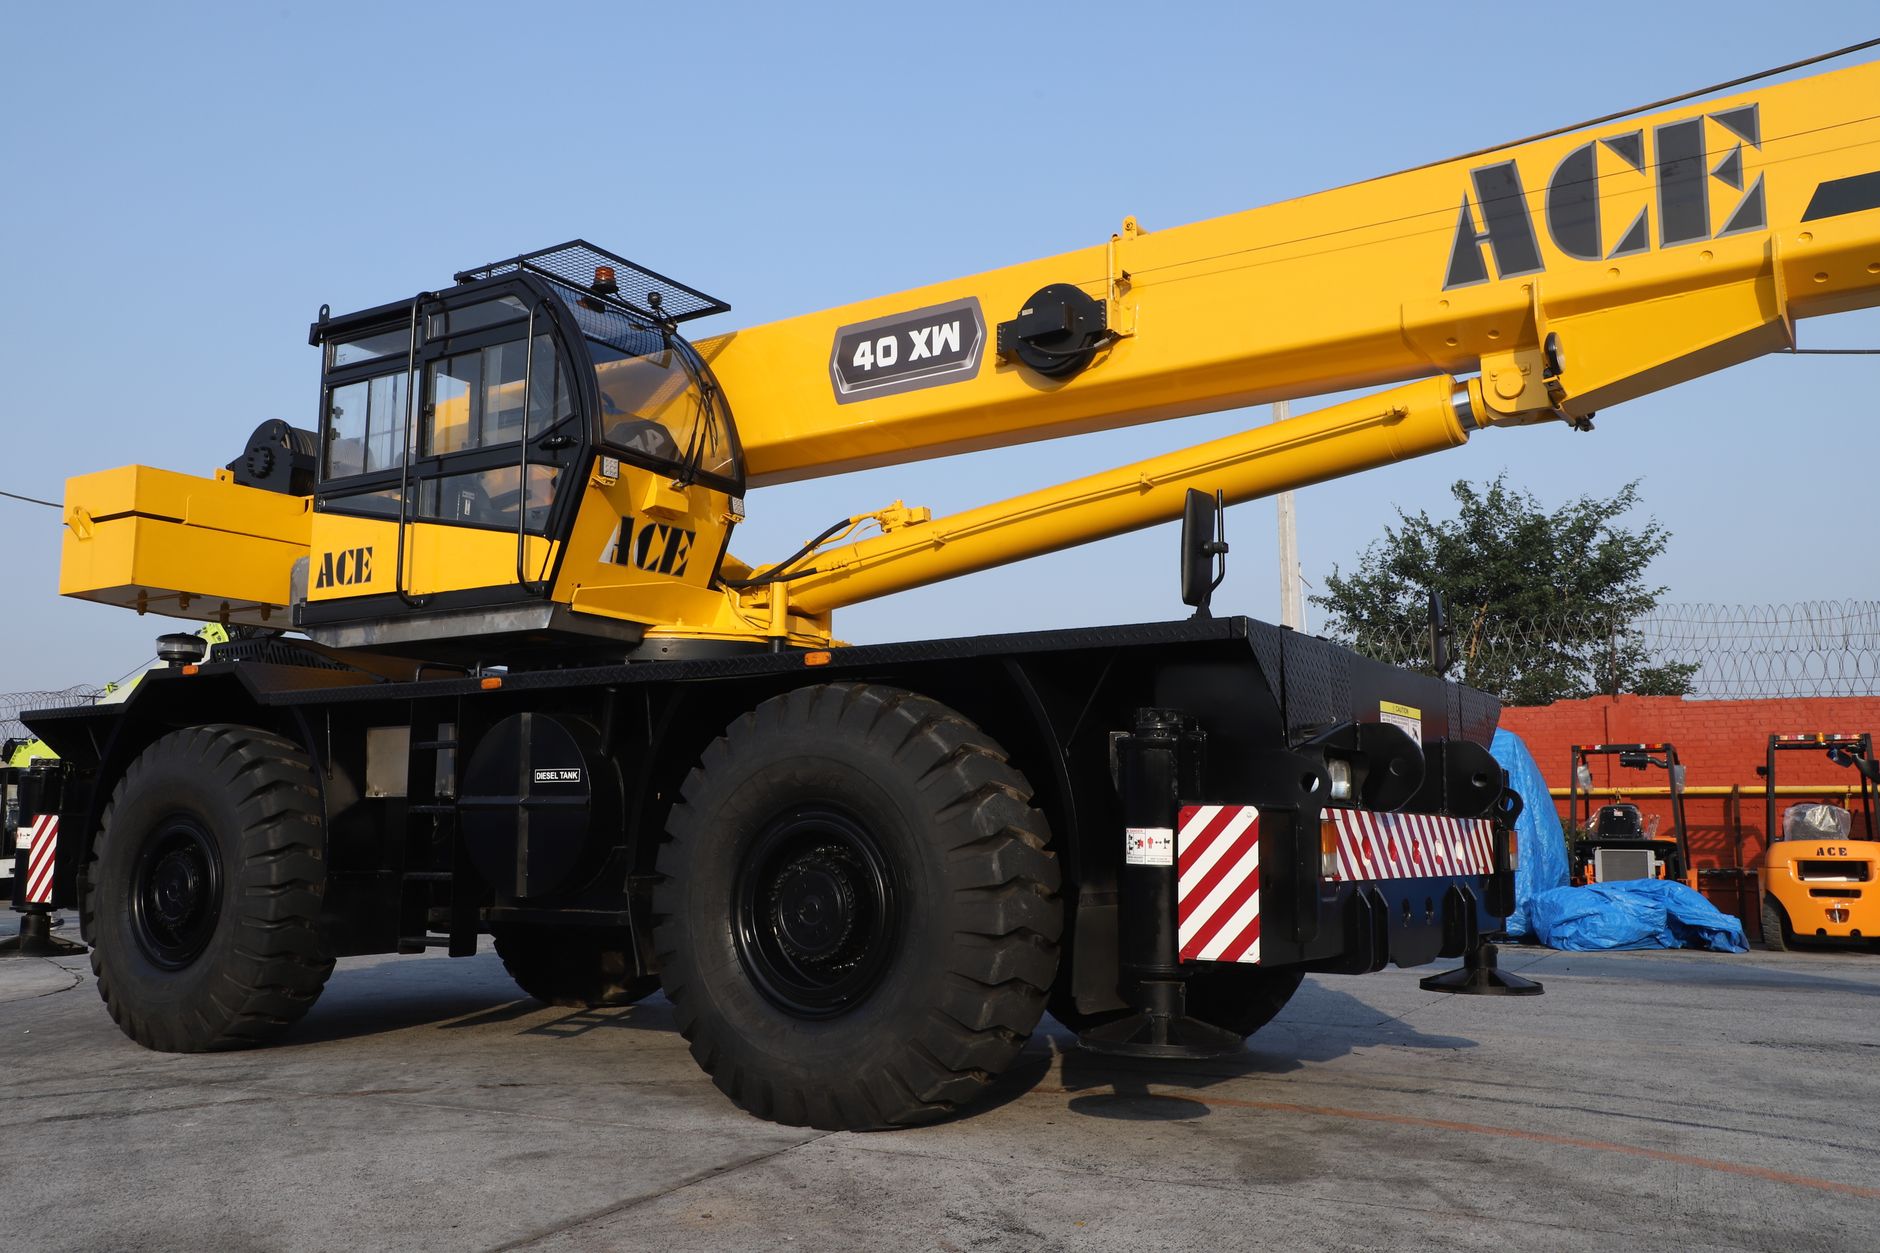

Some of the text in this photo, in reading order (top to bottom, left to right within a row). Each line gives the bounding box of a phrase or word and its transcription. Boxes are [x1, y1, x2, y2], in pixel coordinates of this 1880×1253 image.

[1442, 102, 1767, 292] ACE
[853, 321, 960, 371] 40 XW
[316, 546, 373, 589] ACE
[598, 516, 696, 577] ACE
[536, 771, 578, 780] DIESEL TANK
[1816, 847, 1848, 856] ACE
